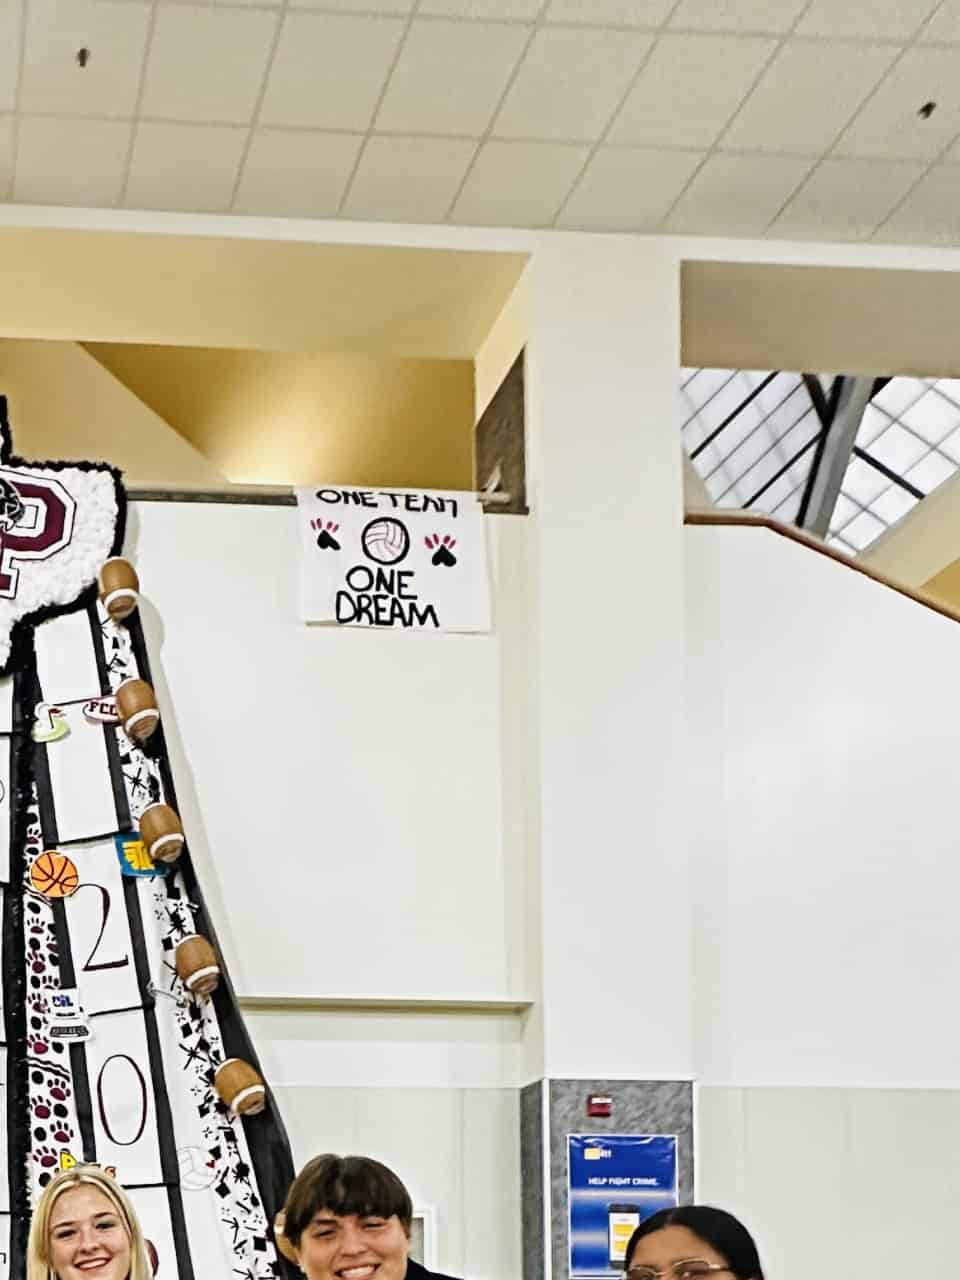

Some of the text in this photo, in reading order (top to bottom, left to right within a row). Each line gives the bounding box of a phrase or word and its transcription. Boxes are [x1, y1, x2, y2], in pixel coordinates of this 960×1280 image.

[315, 488, 378, 508] ONE
[345, 565, 418, 600] ONE
[335, 590, 440, 628] DREAM
[588, 1176, 607, 1186] HELP
[608, 1176, 631, 1187] FIGHT
